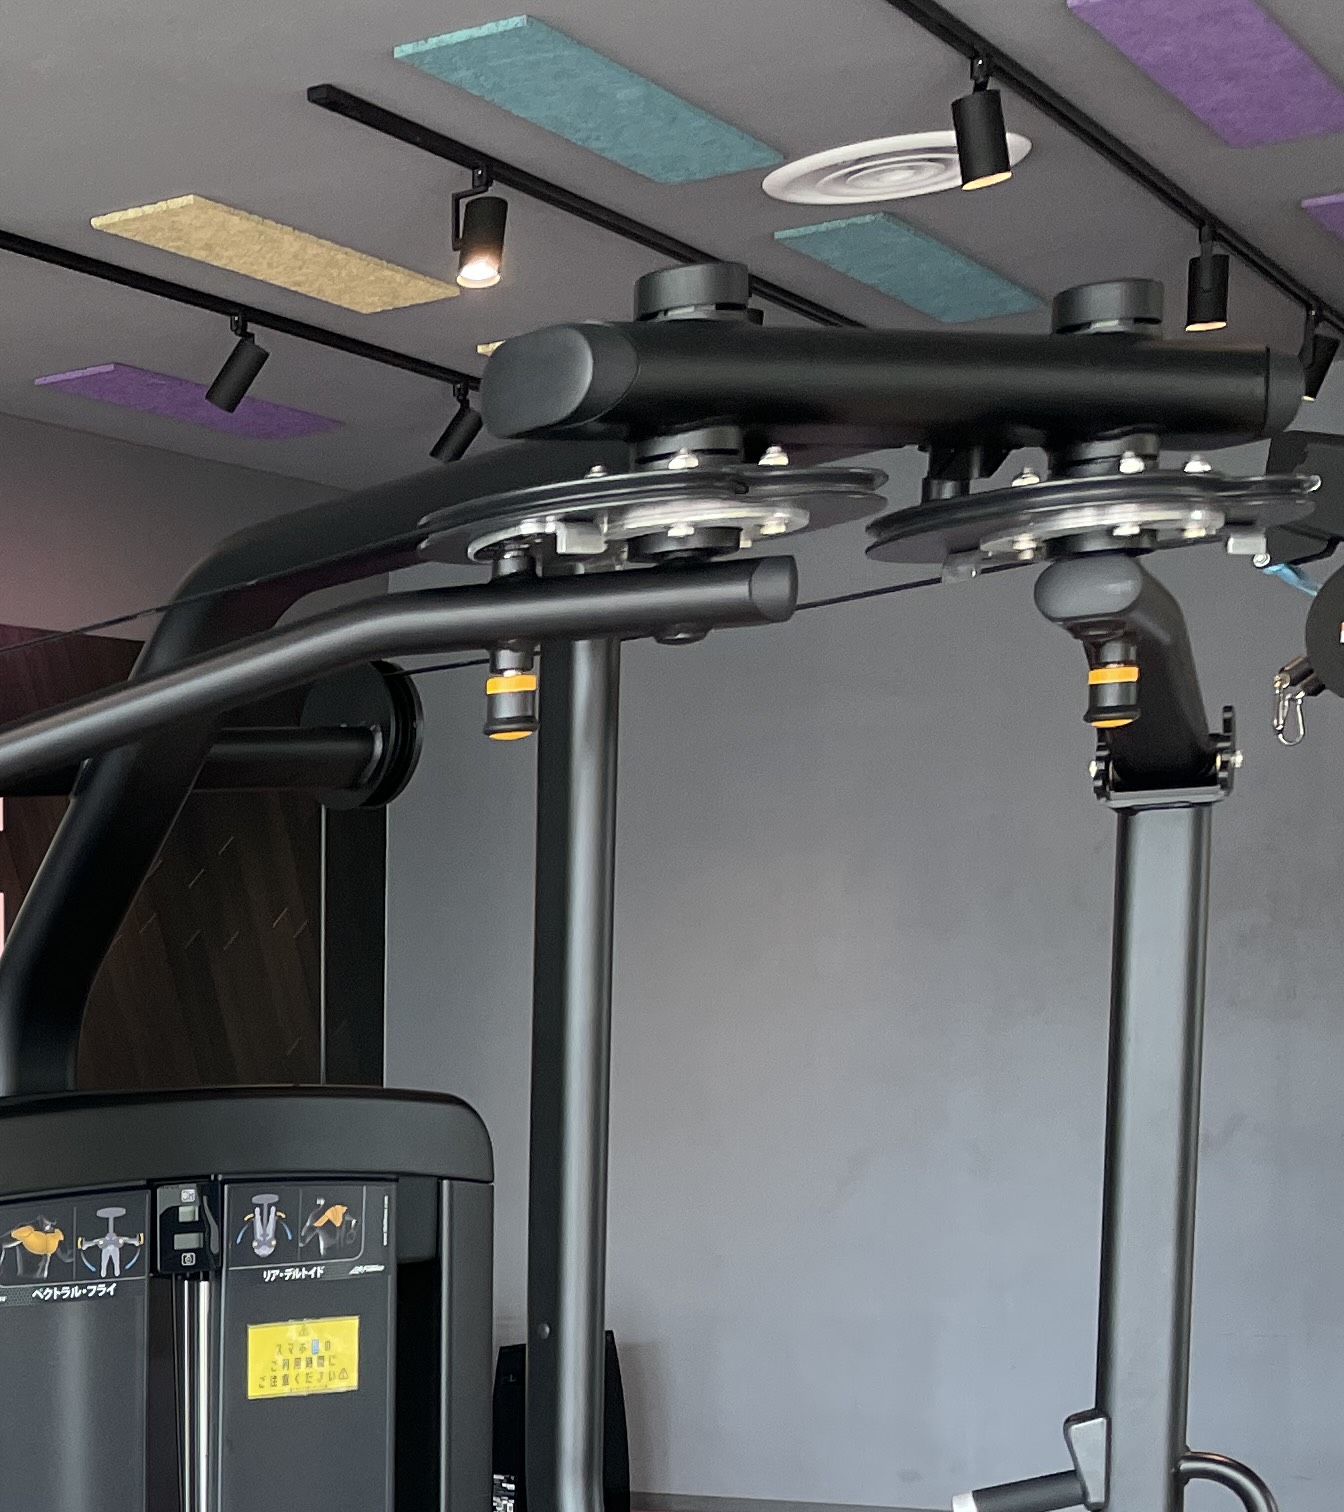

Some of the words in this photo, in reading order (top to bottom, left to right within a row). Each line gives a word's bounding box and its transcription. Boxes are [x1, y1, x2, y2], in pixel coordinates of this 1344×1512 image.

[263, 1266, 325, 1282] リア・デルトイド
[32, 1283, 117, 1300] ペクトラル・フライ
